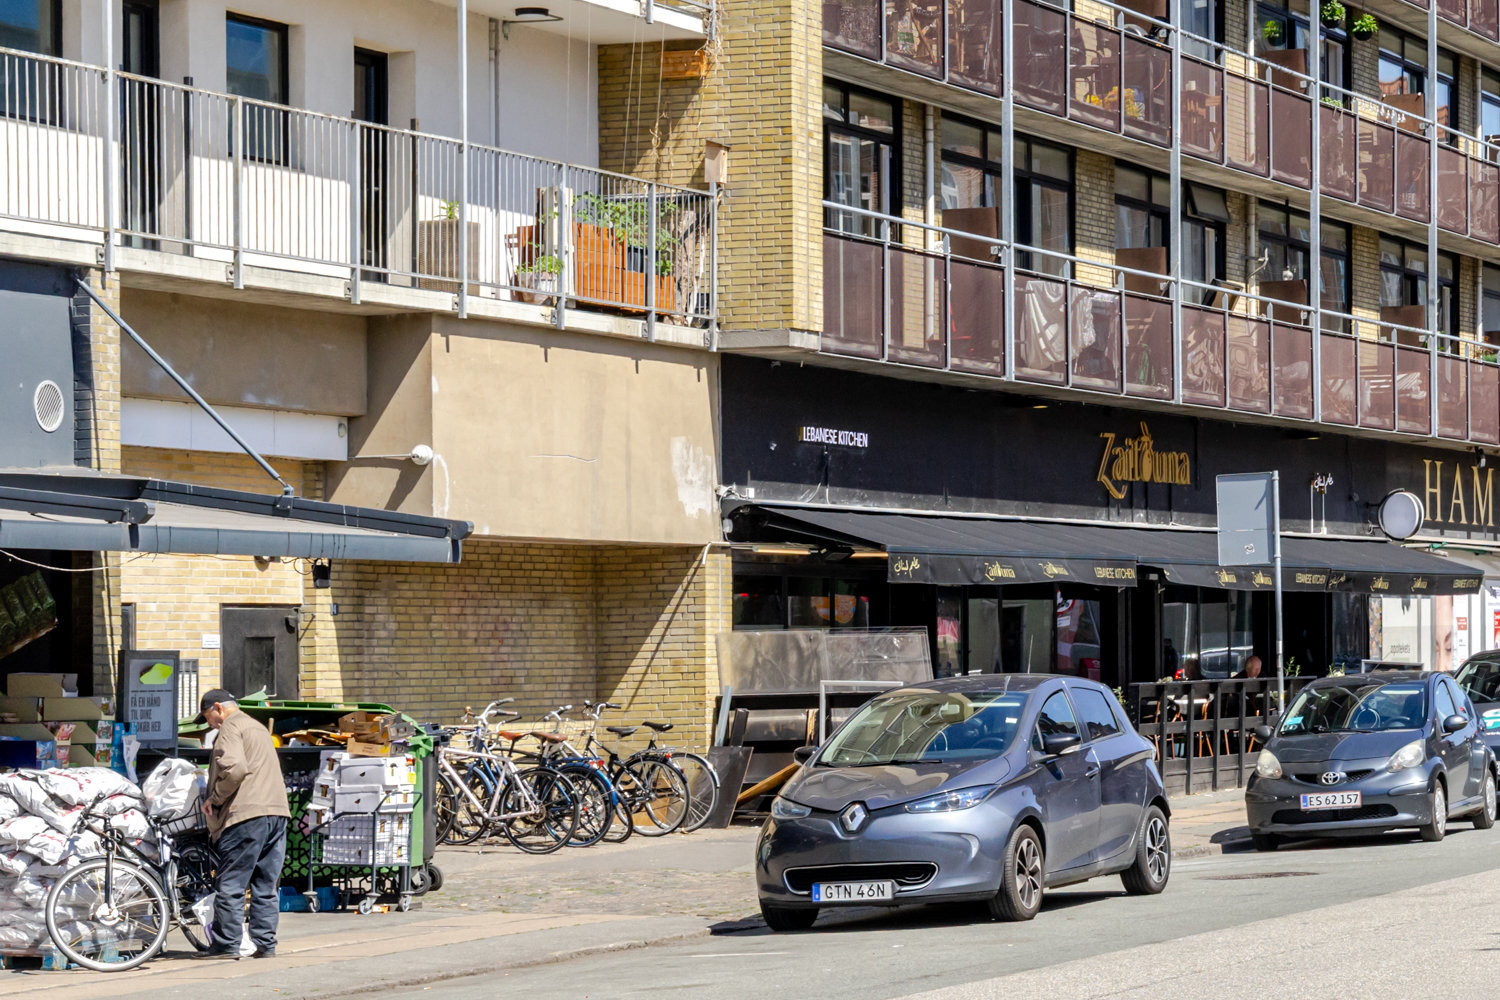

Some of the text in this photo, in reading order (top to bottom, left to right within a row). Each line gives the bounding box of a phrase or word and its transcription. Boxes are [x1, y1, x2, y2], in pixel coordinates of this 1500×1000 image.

[802, 426, 869, 448] LEBANESE KITCHEN
[131, 694, 161, 707] FÅ EN HÅND
[140, 709, 152, 719] DINE
[151, 721, 161, 732] HER
[1308, 793, 1359, 807] ES 62 157
[824, 882, 886, 900] GTN 46N
